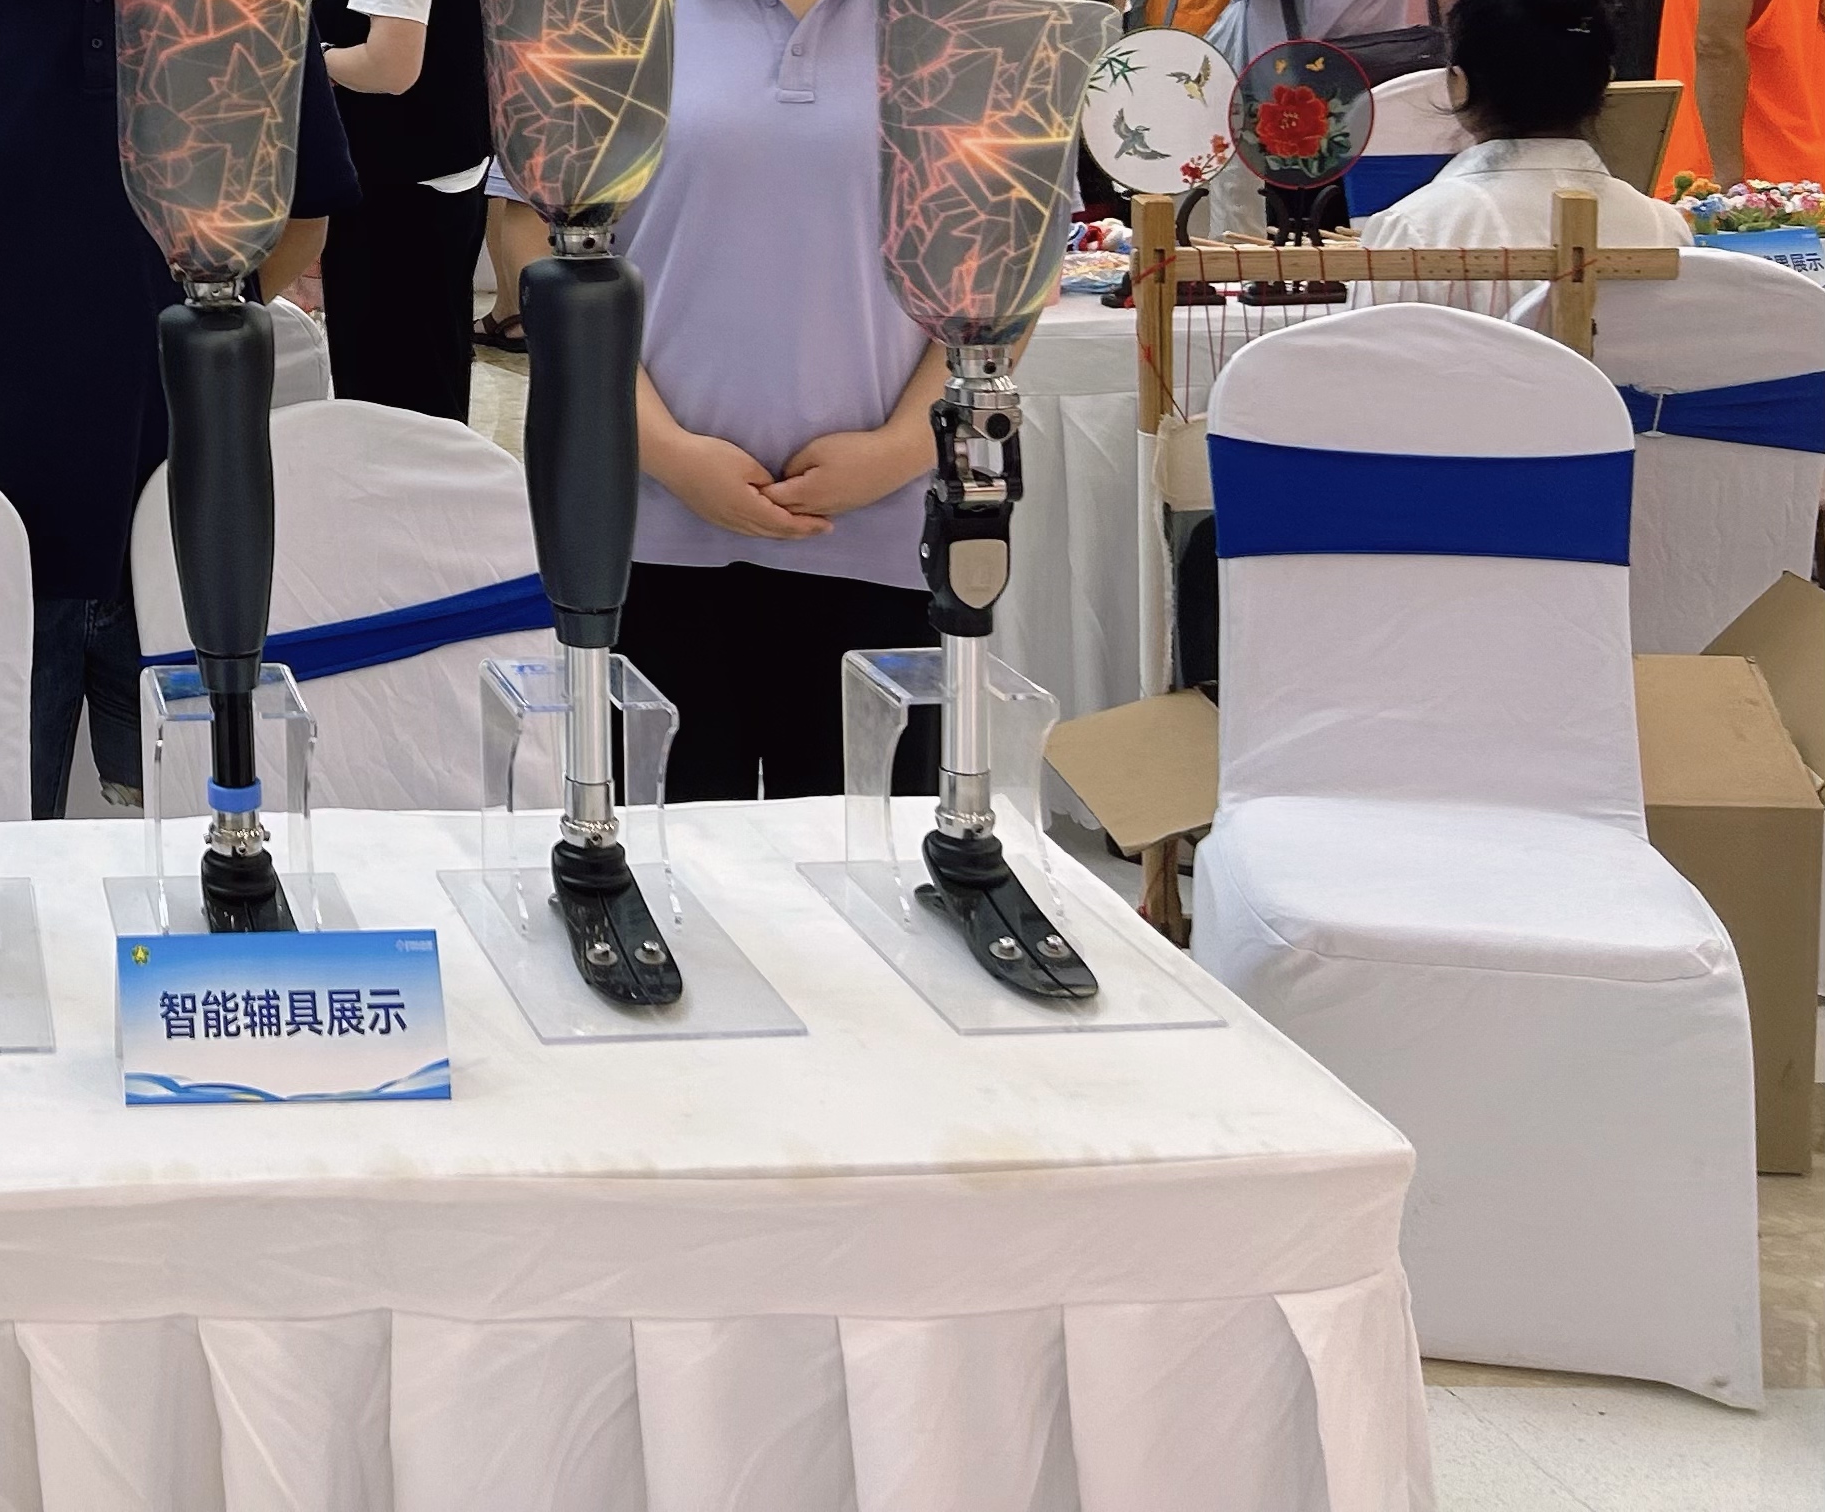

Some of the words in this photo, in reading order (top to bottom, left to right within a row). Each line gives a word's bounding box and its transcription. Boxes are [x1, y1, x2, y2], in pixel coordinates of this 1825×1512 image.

[159, 989, 408, 1039] 智能辅具展示
